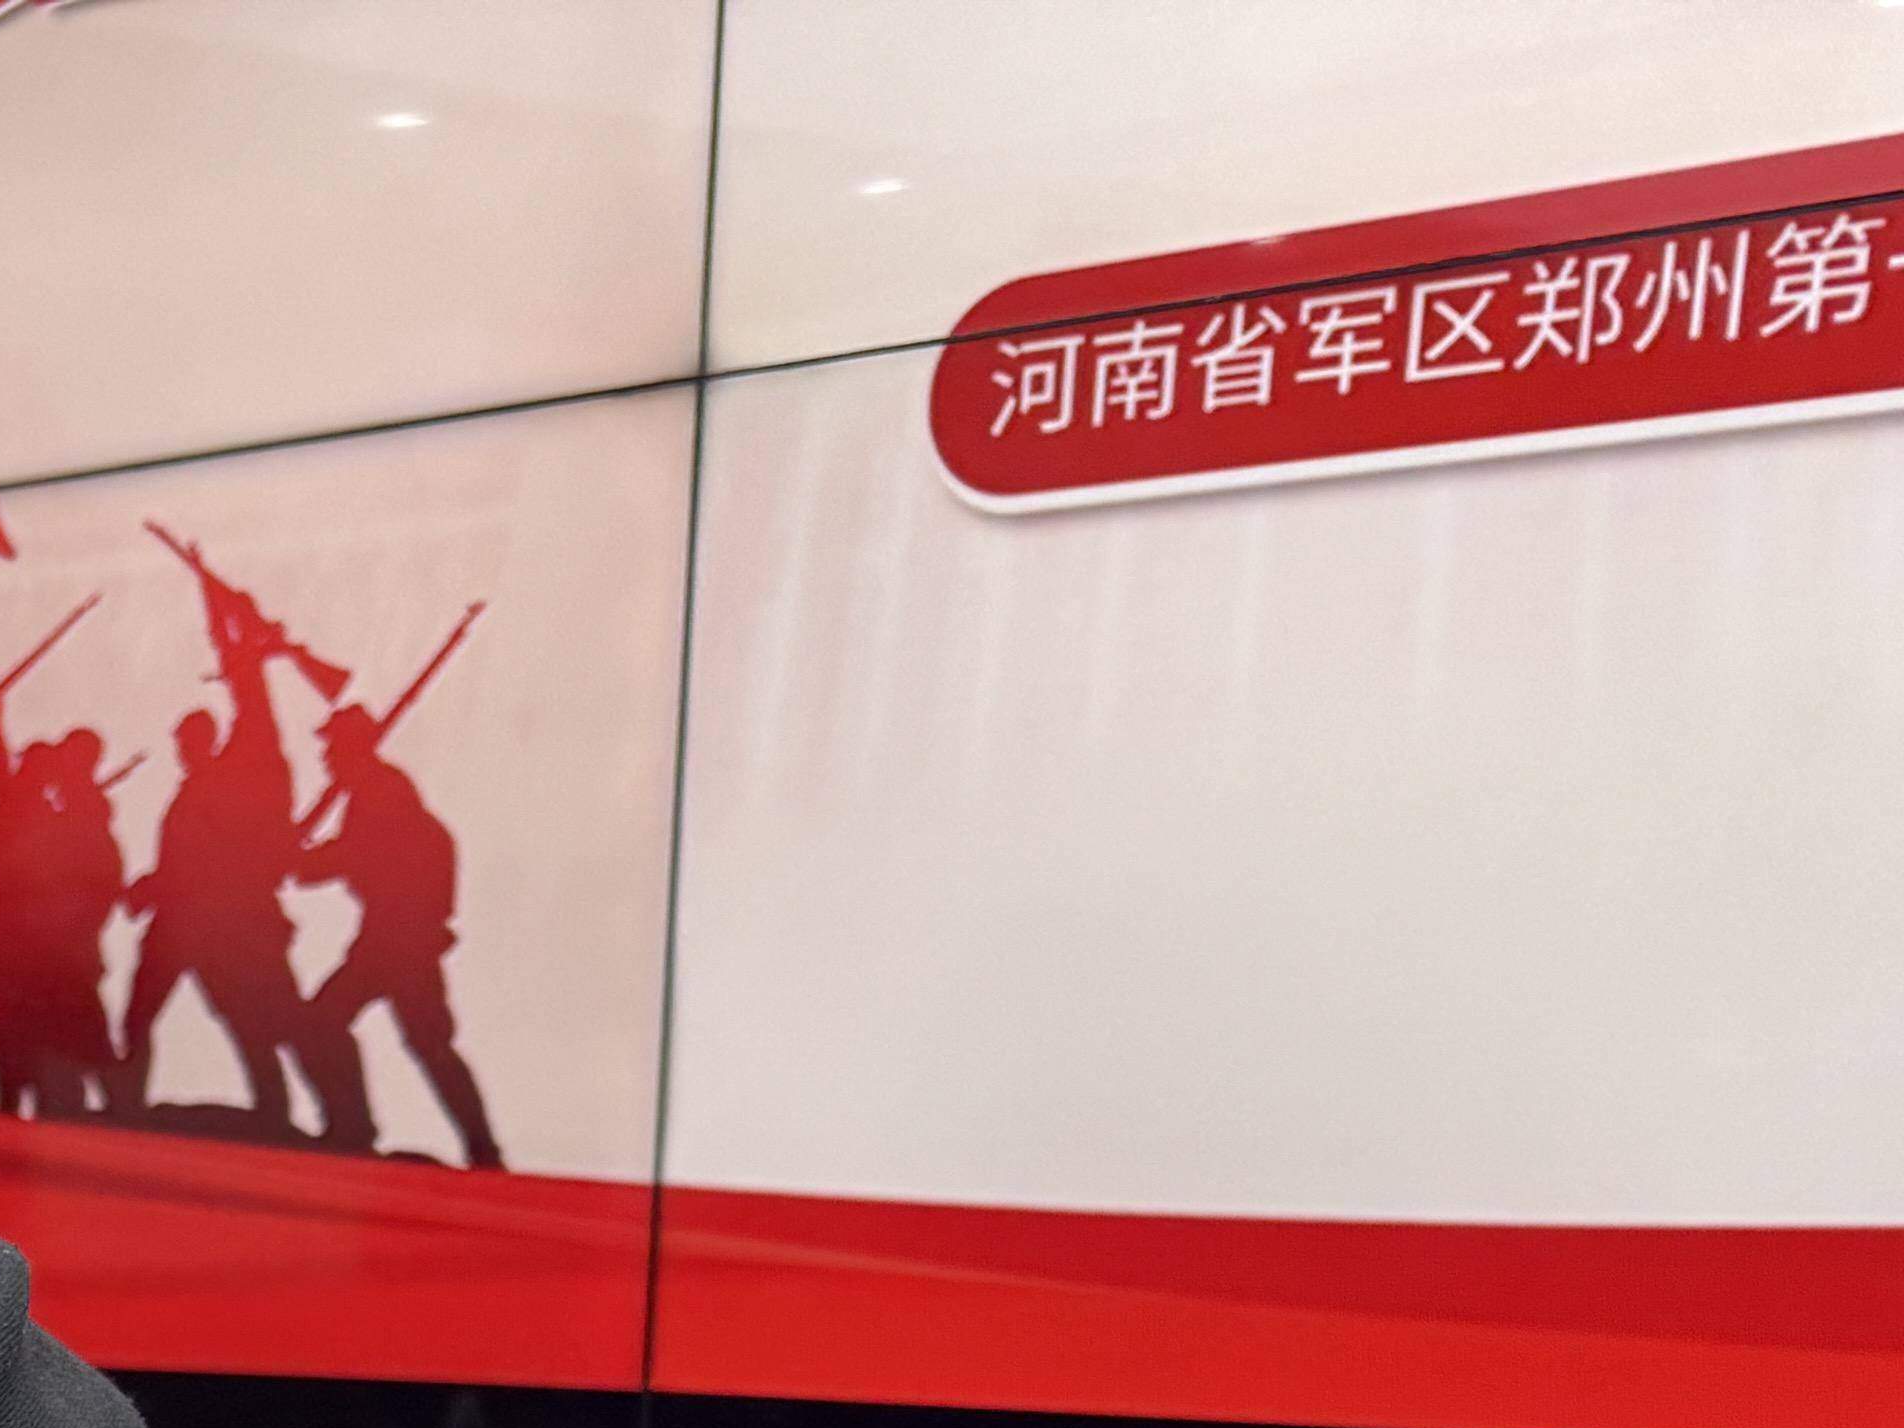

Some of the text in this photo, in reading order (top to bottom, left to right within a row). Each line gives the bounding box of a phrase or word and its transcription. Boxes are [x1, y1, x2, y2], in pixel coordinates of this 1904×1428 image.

[990, 213, 1904, 438] 河南省军区郑州第
